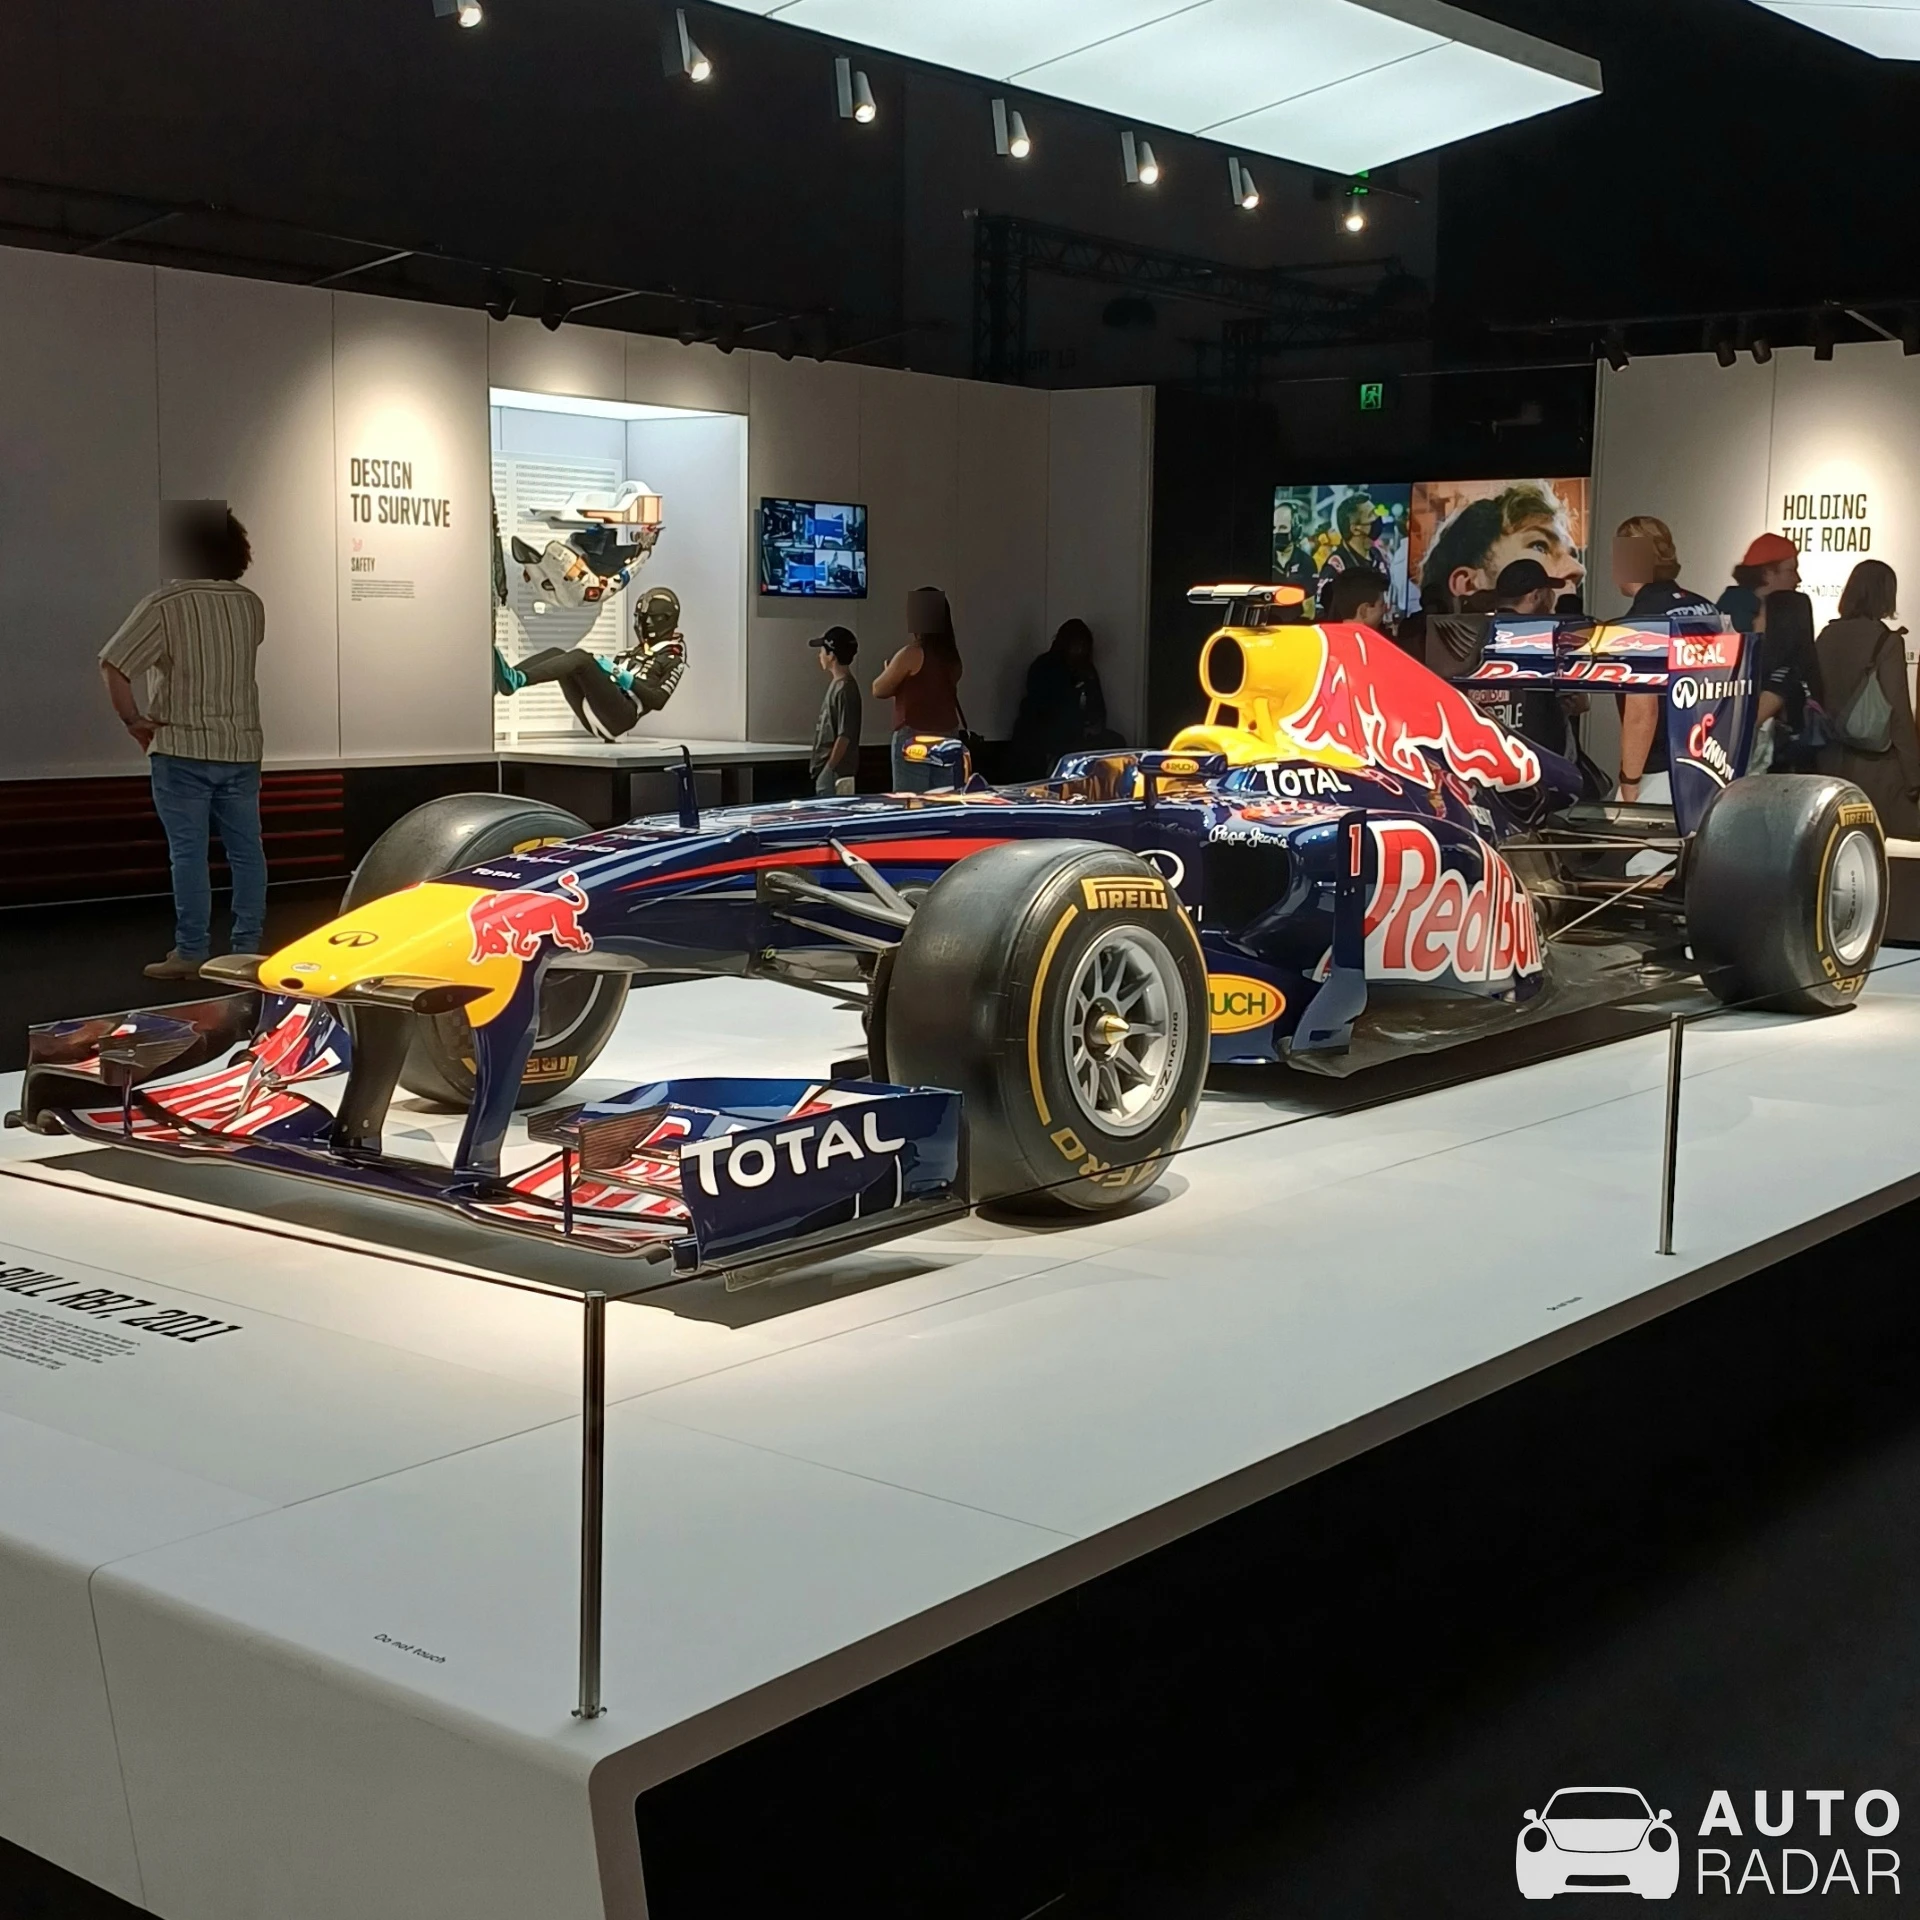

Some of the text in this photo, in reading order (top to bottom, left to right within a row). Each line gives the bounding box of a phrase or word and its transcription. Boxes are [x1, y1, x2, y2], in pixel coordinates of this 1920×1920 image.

[351, 457, 413, 490] DESIGN
[350, 493, 451, 528] TO SURVIVE
[1783, 493, 1868, 520] HOLDING
[1782, 526, 1871, 552] THE ROAD
[351, 557, 375, 572] SAFETY
[1673, 639, 1726, 666] TOTAL
[1700, 679, 1752, 700] INFINITI
[1256, 763, 1352, 797] TOTAL
[1837, 803, 1875, 827] PIRELLI
[1209, 824, 1248, 847] Pepe
[1246, 827, 1289, 848] Jeans
[1349, 824, 1361, 877] 1
[471, 866, 522, 880] TOTAL
[1080, 875, 1168, 910] PIRELLI
[1363, 822, 1494, 980] Red
[1210, 991, 1266, 1016] UCH
[1167, 1011, 1179, 1067] RACING
[681, 1112, 906, 1196] TOTAL
[46, 1288, 157, 1320] RB7,
[119, 1308, 243, 1343] 2011
[374, 1633, 447, 1664] Do not touch
